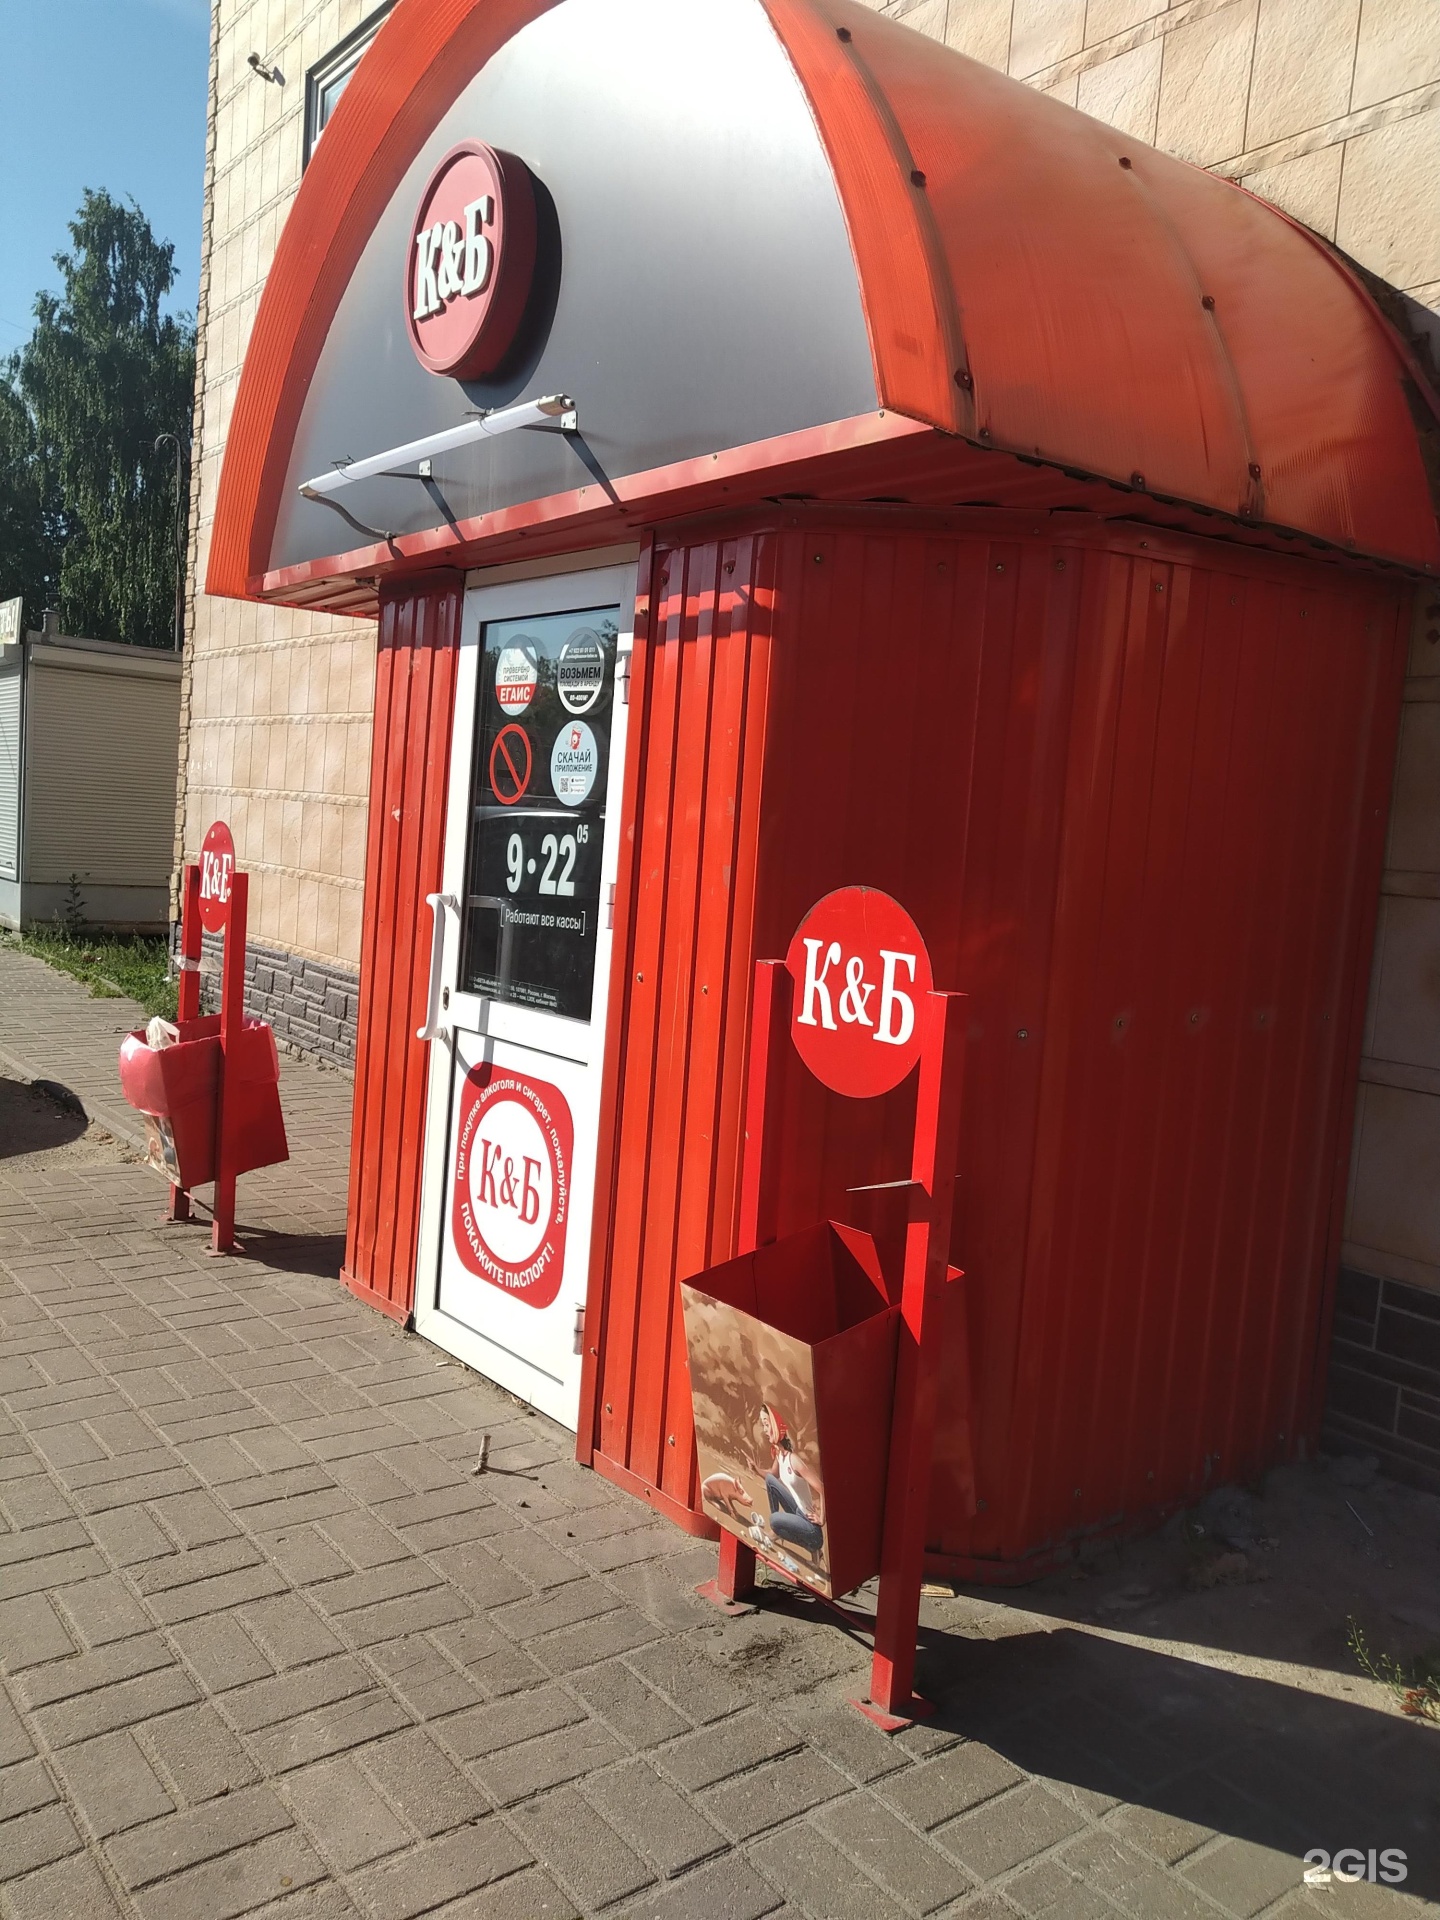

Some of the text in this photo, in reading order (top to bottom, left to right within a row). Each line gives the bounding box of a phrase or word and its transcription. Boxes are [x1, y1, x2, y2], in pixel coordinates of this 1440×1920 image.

[413, 194, 490, 320] К&Б
[503, 666, 530, 674] ПРОВЕРЕНО
[504, 673, 528, 682] СИСТЕМОЙ
[560, 666, 601, 679] ВОЗЬМЕМ
[500, 686, 530, 702] ЕГАИС
[557, 749, 591, 763] СКАЧАЙ
[554, 764, 593, 772] ПРИЛОЖЕНИЕ
[541, 914, 555, 927] все
[797, 937, 916, 1046] К&Б
[480, 1079, 515, 1102] алкоголя
[515, 1082, 522, 1092] и
[460, 1099, 481, 1149] покупке
[457, 1151, 466, 1180] При
[476, 1138, 542, 1225] К&Б
[549, 1127, 568, 1225] пожалуйста,
[460, 1202, 555, 1288] ПОКАЖИТЕ ПАСПОРТ!
